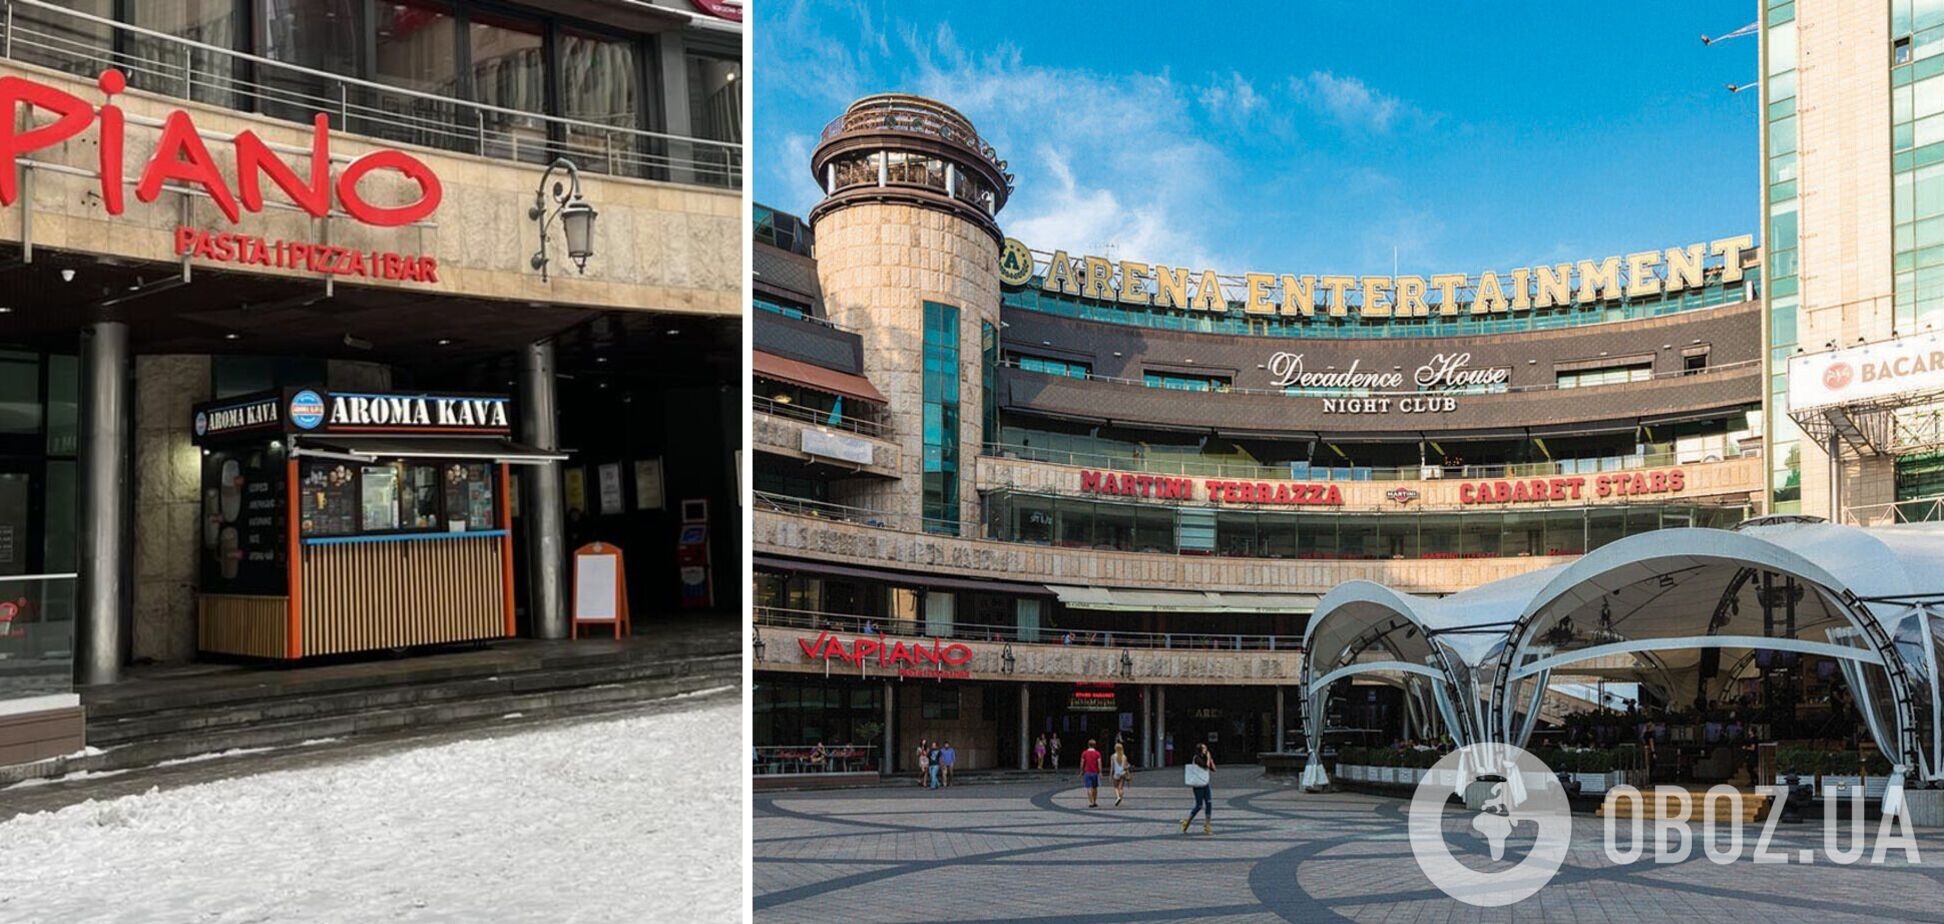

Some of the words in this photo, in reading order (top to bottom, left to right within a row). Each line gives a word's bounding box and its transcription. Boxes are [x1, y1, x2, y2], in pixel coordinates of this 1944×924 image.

[175, 226, 275, 266] PASTA
[289, 242, 365, 276] PIZZA
[384, 252, 439, 284] BAR
[1043, 249, 1229, 312] ARENA
[1244, 234, 1753, 318] ENTERTAINMENT
[1268, 352, 1403, 387] Decadence
[1414, 352, 1507, 387] House
[208, 409, 245, 431] AROMA
[247, 402, 278, 425] KAVA
[330, 396, 431, 425] AROMA
[439, 399, 508, 426] KAVA
[1323, 398, 1390, 414] NIGHT
[1399, 397, 1457, 412] CLUB
[1081, 470, 1192, 500] MARTINI
[1206, 479, 1342, 506] TERRAZZA
[1459, 477, 1586, 504] CABARET
[1595, 469, 1685, 497] STARS
